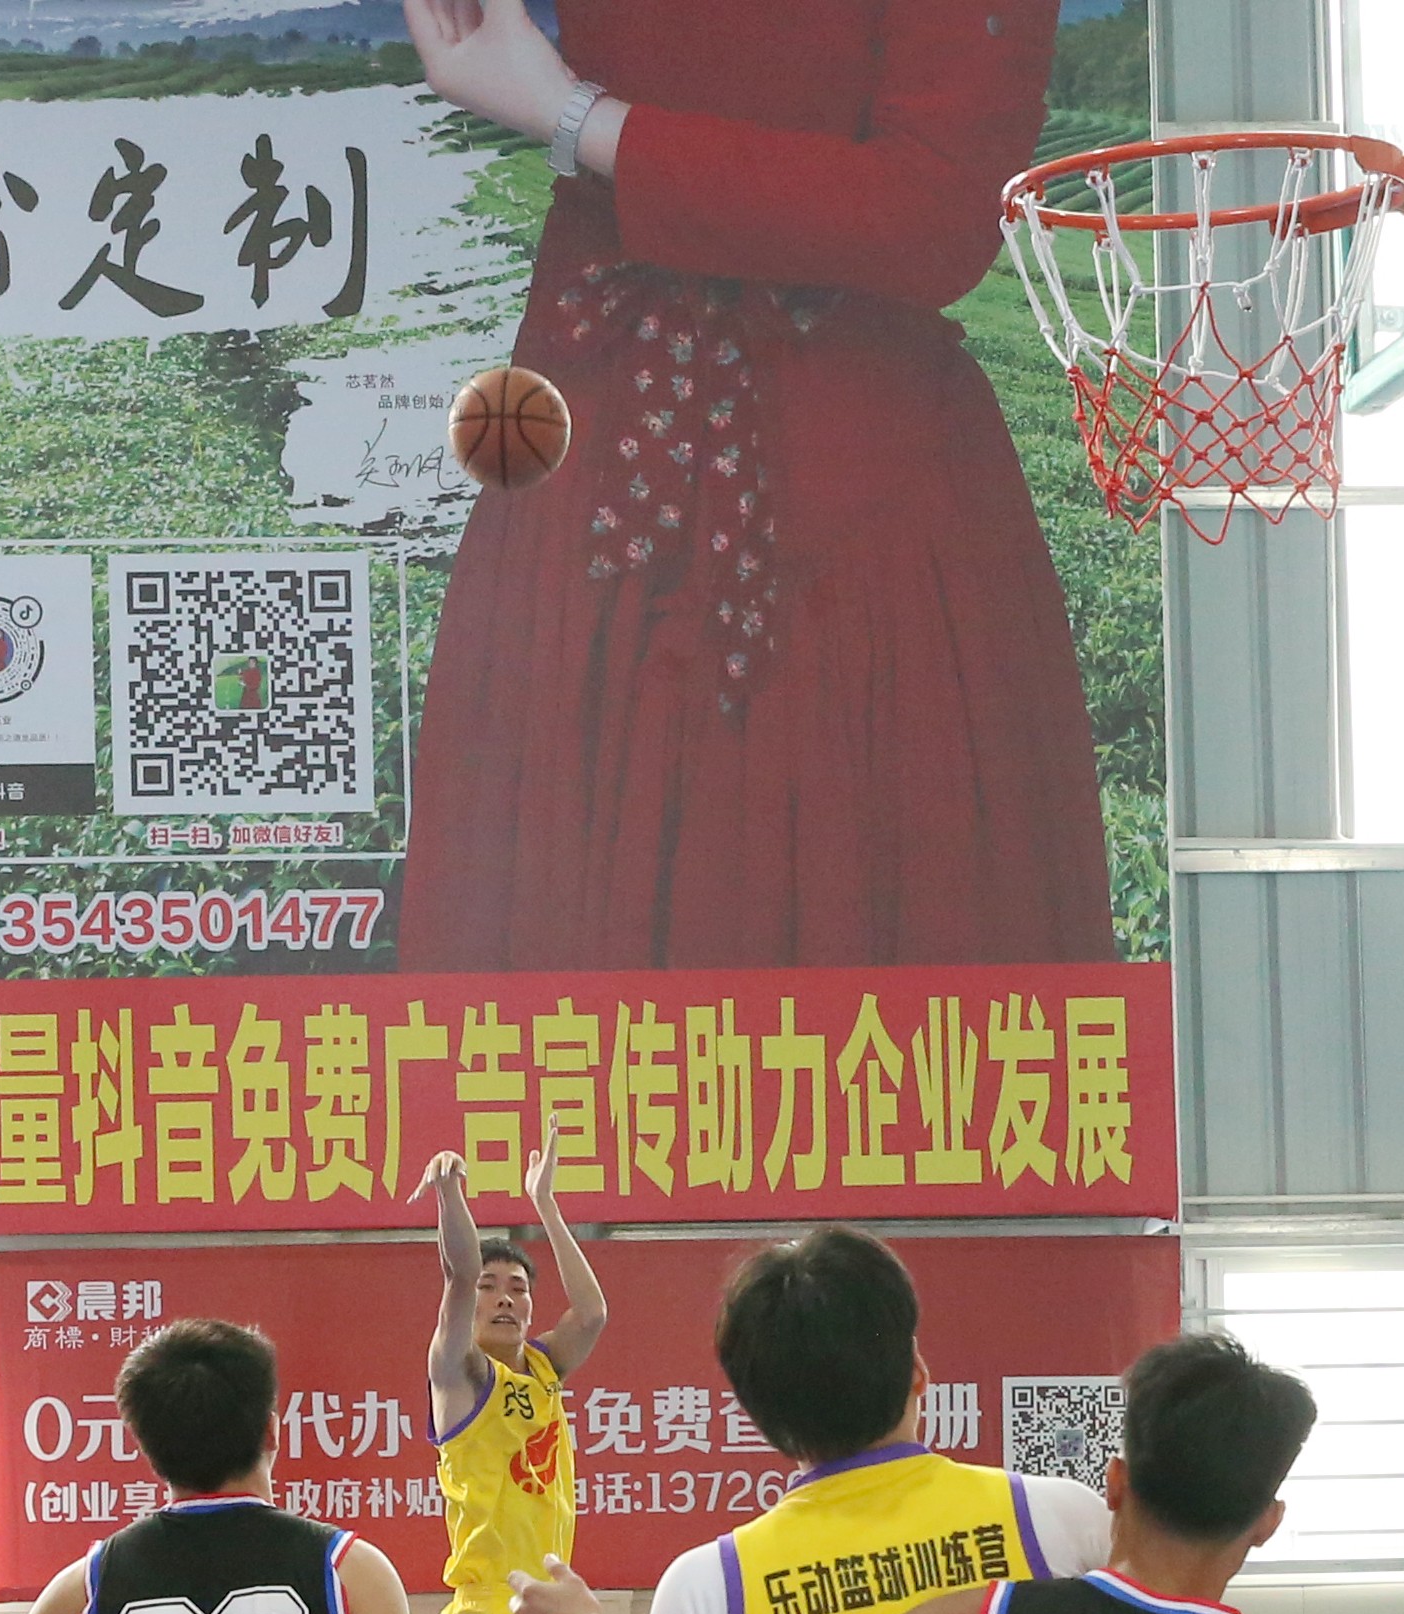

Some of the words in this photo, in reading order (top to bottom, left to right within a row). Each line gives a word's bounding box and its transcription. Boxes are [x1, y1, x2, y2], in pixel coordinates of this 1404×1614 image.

[77, 1281, 162, 1321] 晨邦
[282, 1390, 413, 1459] 代办
[920, 1382, 983, 1449] 册
[271, 1477, 445, 1520] 政府补贴
